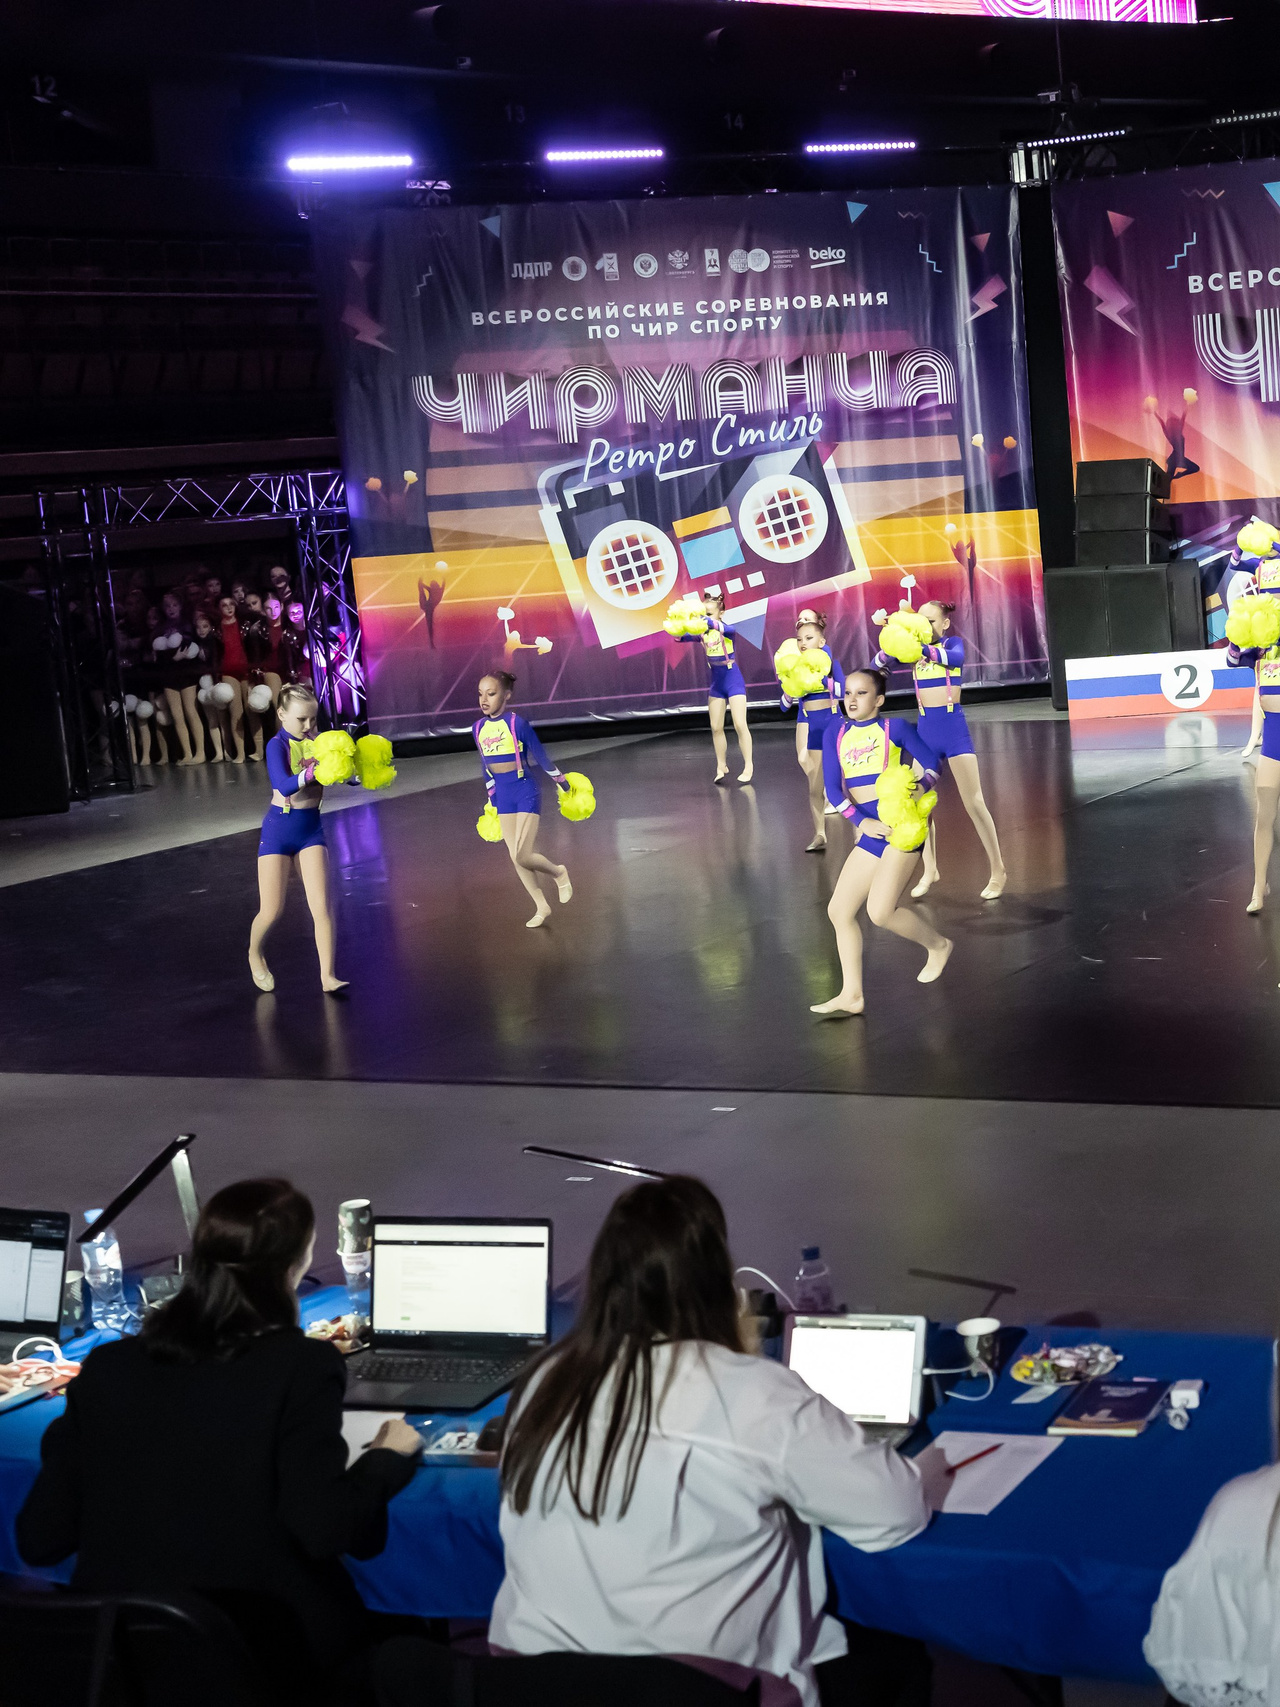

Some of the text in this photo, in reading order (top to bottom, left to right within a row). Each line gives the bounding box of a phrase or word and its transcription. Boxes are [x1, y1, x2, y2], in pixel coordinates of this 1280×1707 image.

[808, 246, 846, 260] beko
[511, 261, 553, 280] ЛДПР
[471, 291, 890, 326] ВСЕРОССИЙСКИЕ СОРЕВНОВАНИЯ
[587, 315, 784, 339] ПО ЧИР СПОРТУ
[582, 412, 824, 483] Ретро Стиль
[1173, 664, 1201, 699] 2
